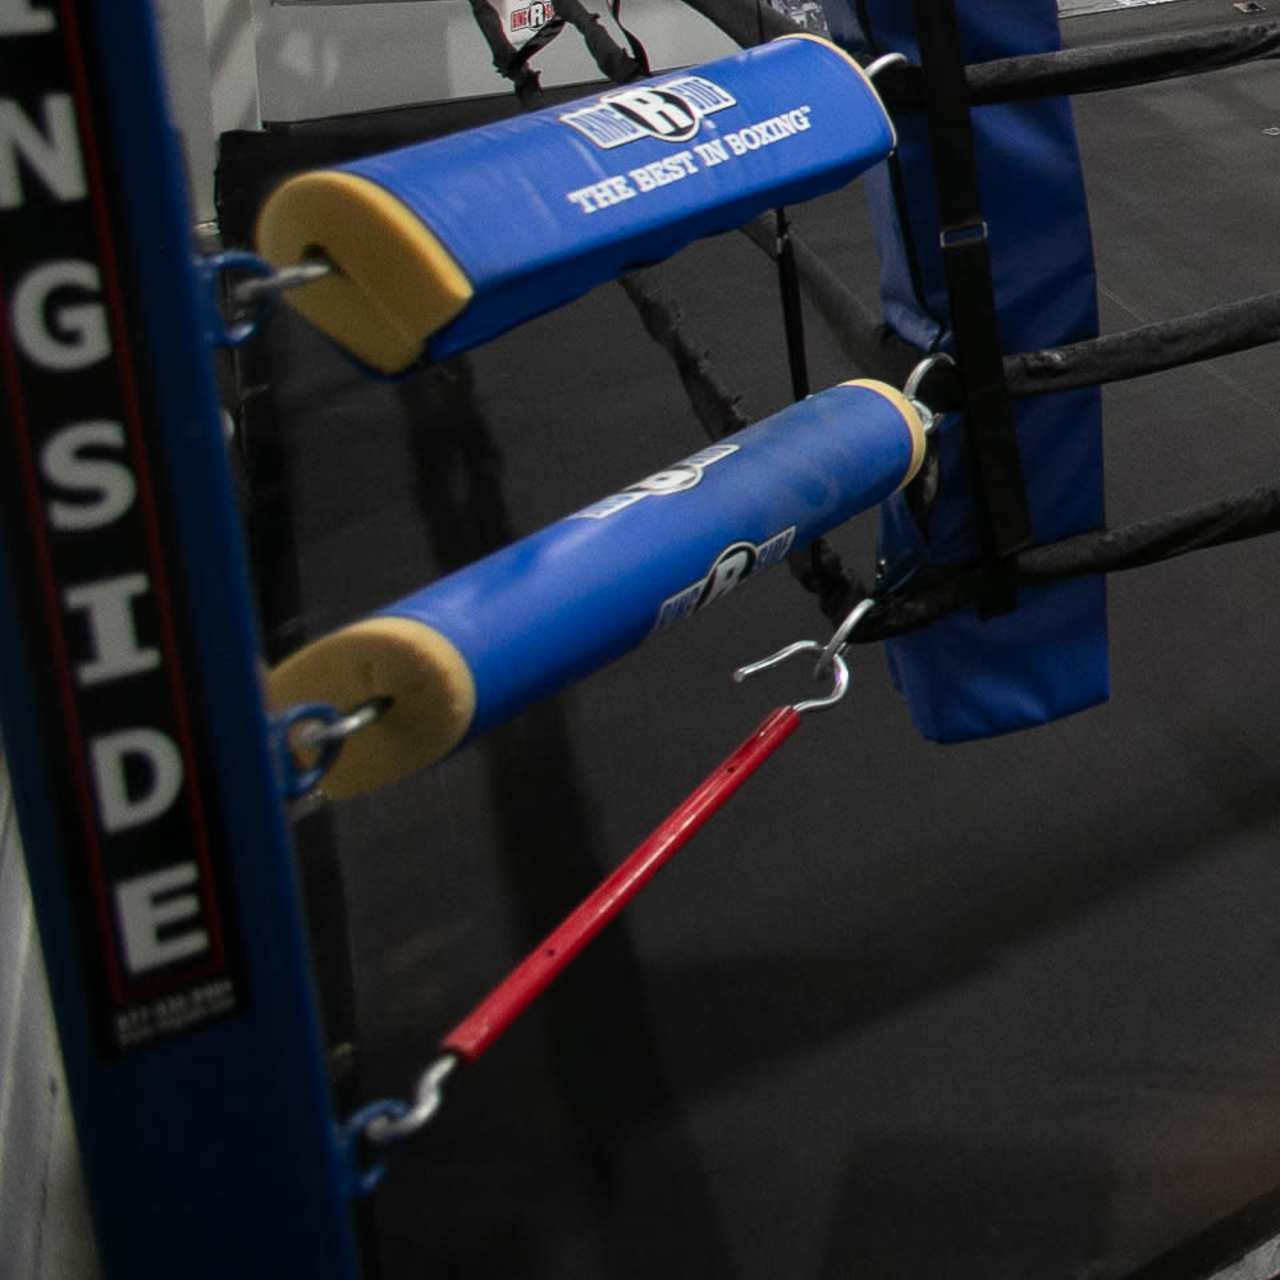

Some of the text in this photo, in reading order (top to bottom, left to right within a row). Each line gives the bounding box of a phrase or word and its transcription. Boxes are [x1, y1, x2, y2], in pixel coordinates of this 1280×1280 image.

[608, 86, 695, 136] R
[567, 110, 811, 214] THE BEST IN BOXING
